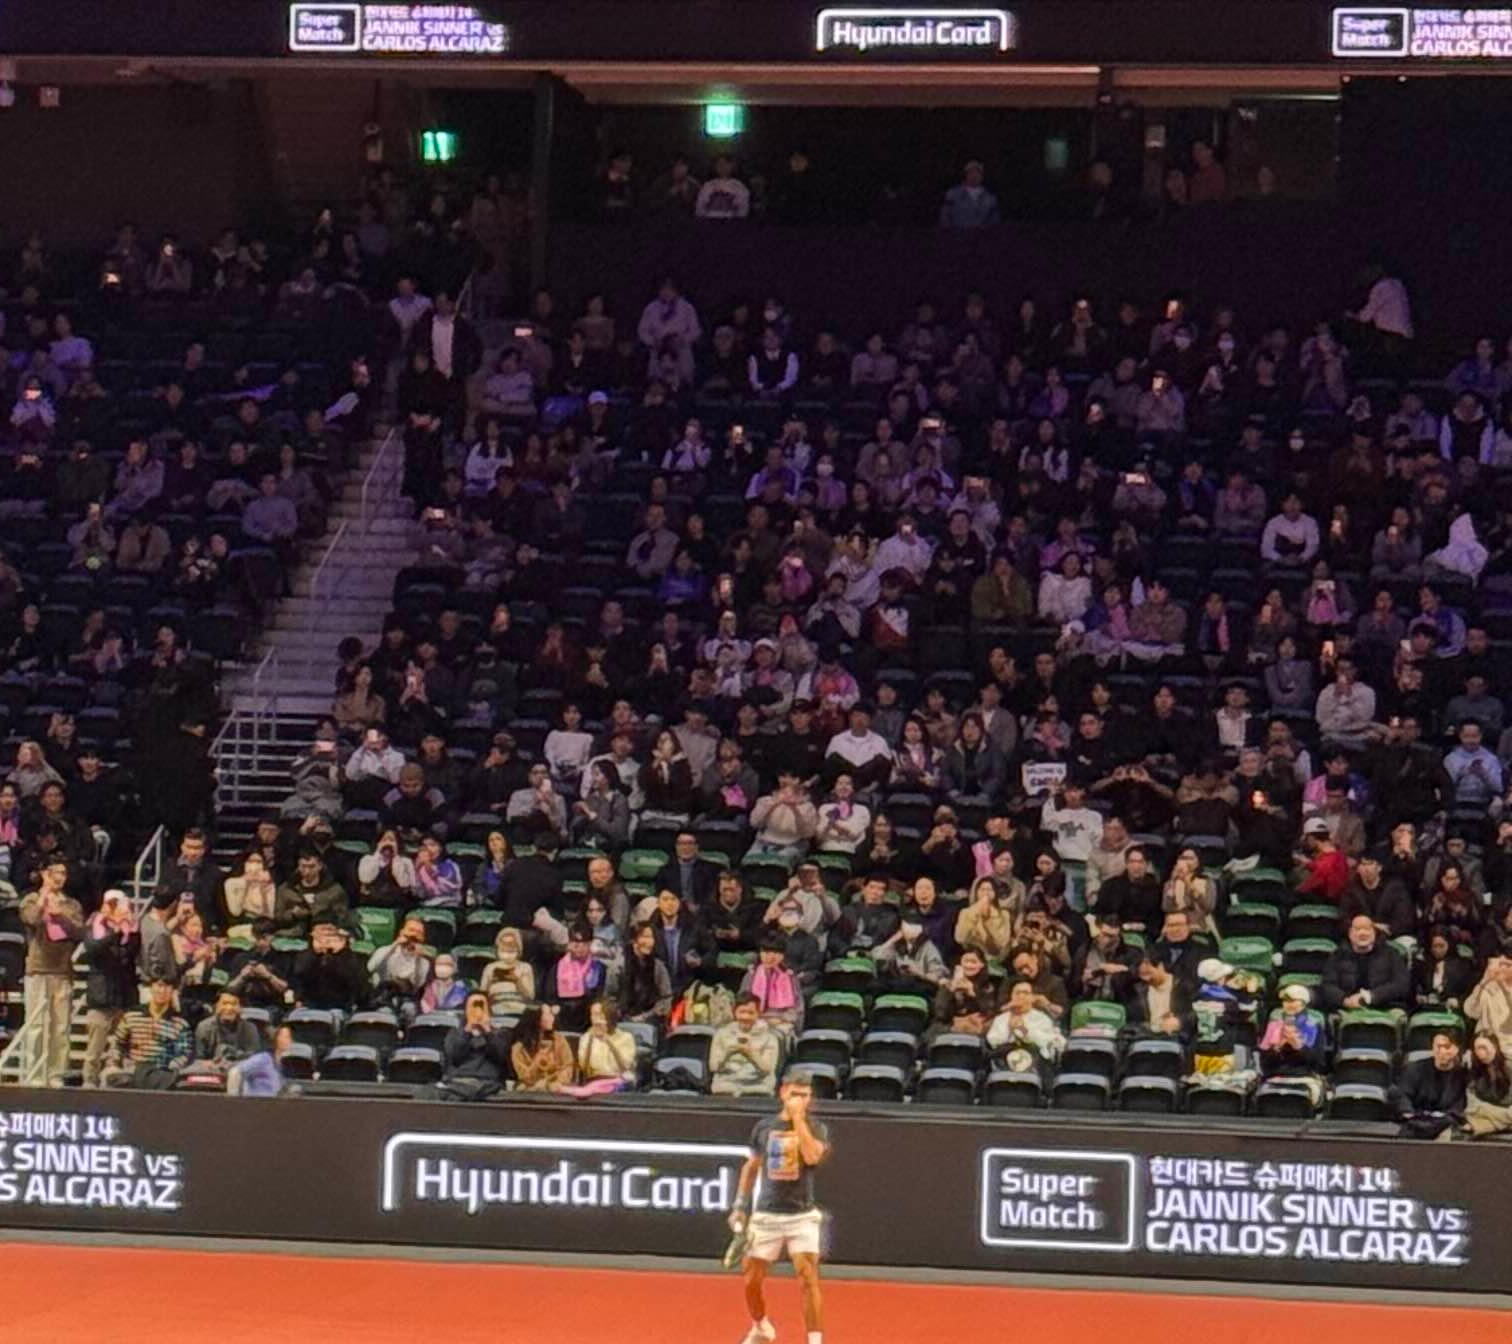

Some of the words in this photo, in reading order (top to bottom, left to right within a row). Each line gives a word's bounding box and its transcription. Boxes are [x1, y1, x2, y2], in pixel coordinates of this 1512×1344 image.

[363, 35, 426, 51] CARLOS
[428, 36, 505, 52] ALCARAZ
[364, 20, 421, 35] JANNIK
[423, 20, 483, 35] SINNER
[833, 20, 934, 50] Hyundai
[936, 20, 992, 45] Card
[1411, 40, 1480, 56] CARLOS
[82, 1116, 114, 1140] 14
[12, 1142, 138, 1175] SINNER
[1150, 1156, 1250, 1186] 현대카드
[1253, 1161, 1353, 1193] 슈퍼매치
[1358, 1166, 1392, 1192] 14
[24, 1174, 181, 1208] ALCARAZ
[415, 1157, 614, 1215] Hyundai
[620, 1166, 729, 1212] Card
[1000, 1166, 1092, 1201] Super
[1000, 1199, 1096, 1230] Match
[1147, 1187, 1276, 1223] JANNIK
[1282, 1193, 1416, 1229] SINNER
[1145, 1221, 1289, 1257] CARLOS
[1293, 1227, 1467, 1266] ALCARAZ
